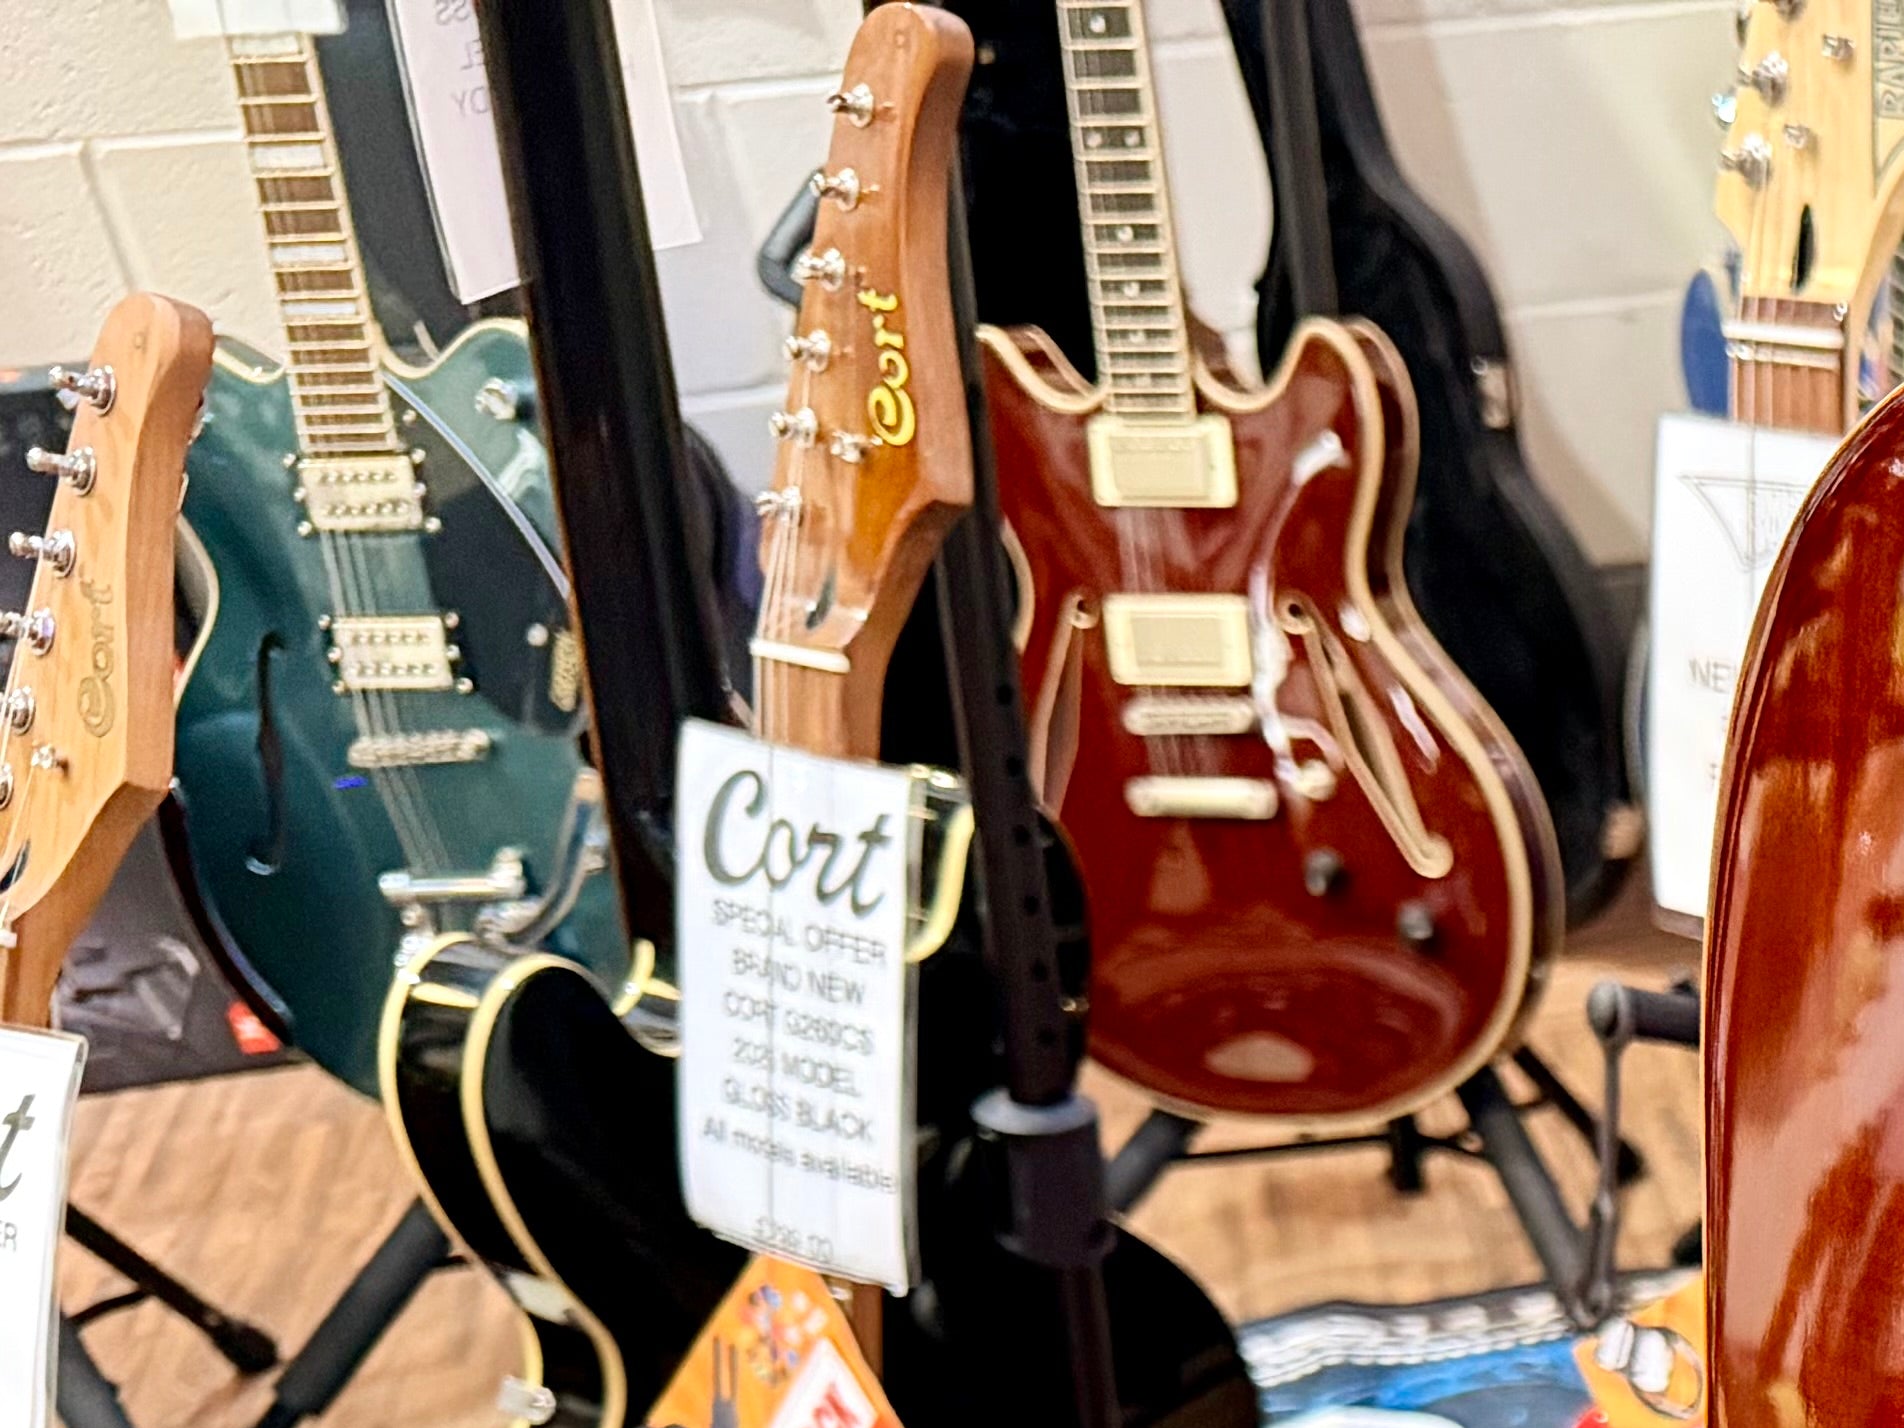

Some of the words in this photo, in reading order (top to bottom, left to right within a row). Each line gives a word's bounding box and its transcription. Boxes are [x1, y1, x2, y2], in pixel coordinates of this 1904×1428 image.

[858, 288, 915, 446] Cort
[79, 562, 115, 737] Cort
[1689, 657, 1737, 693] NE
[703, 769, 893, 916] Cort
[713, 898, 796, 946] SPECIAL
[805, 924, 887, 968] OFFER
[732, 948, 800, 991] BRAND
[808, 970, 864, 1004] NEW
[782, 1052, 862, 1097] MODEL
[723, 1077, 789, 1121] GLOSS
[796, 1099, 873, 1143] BLACK
